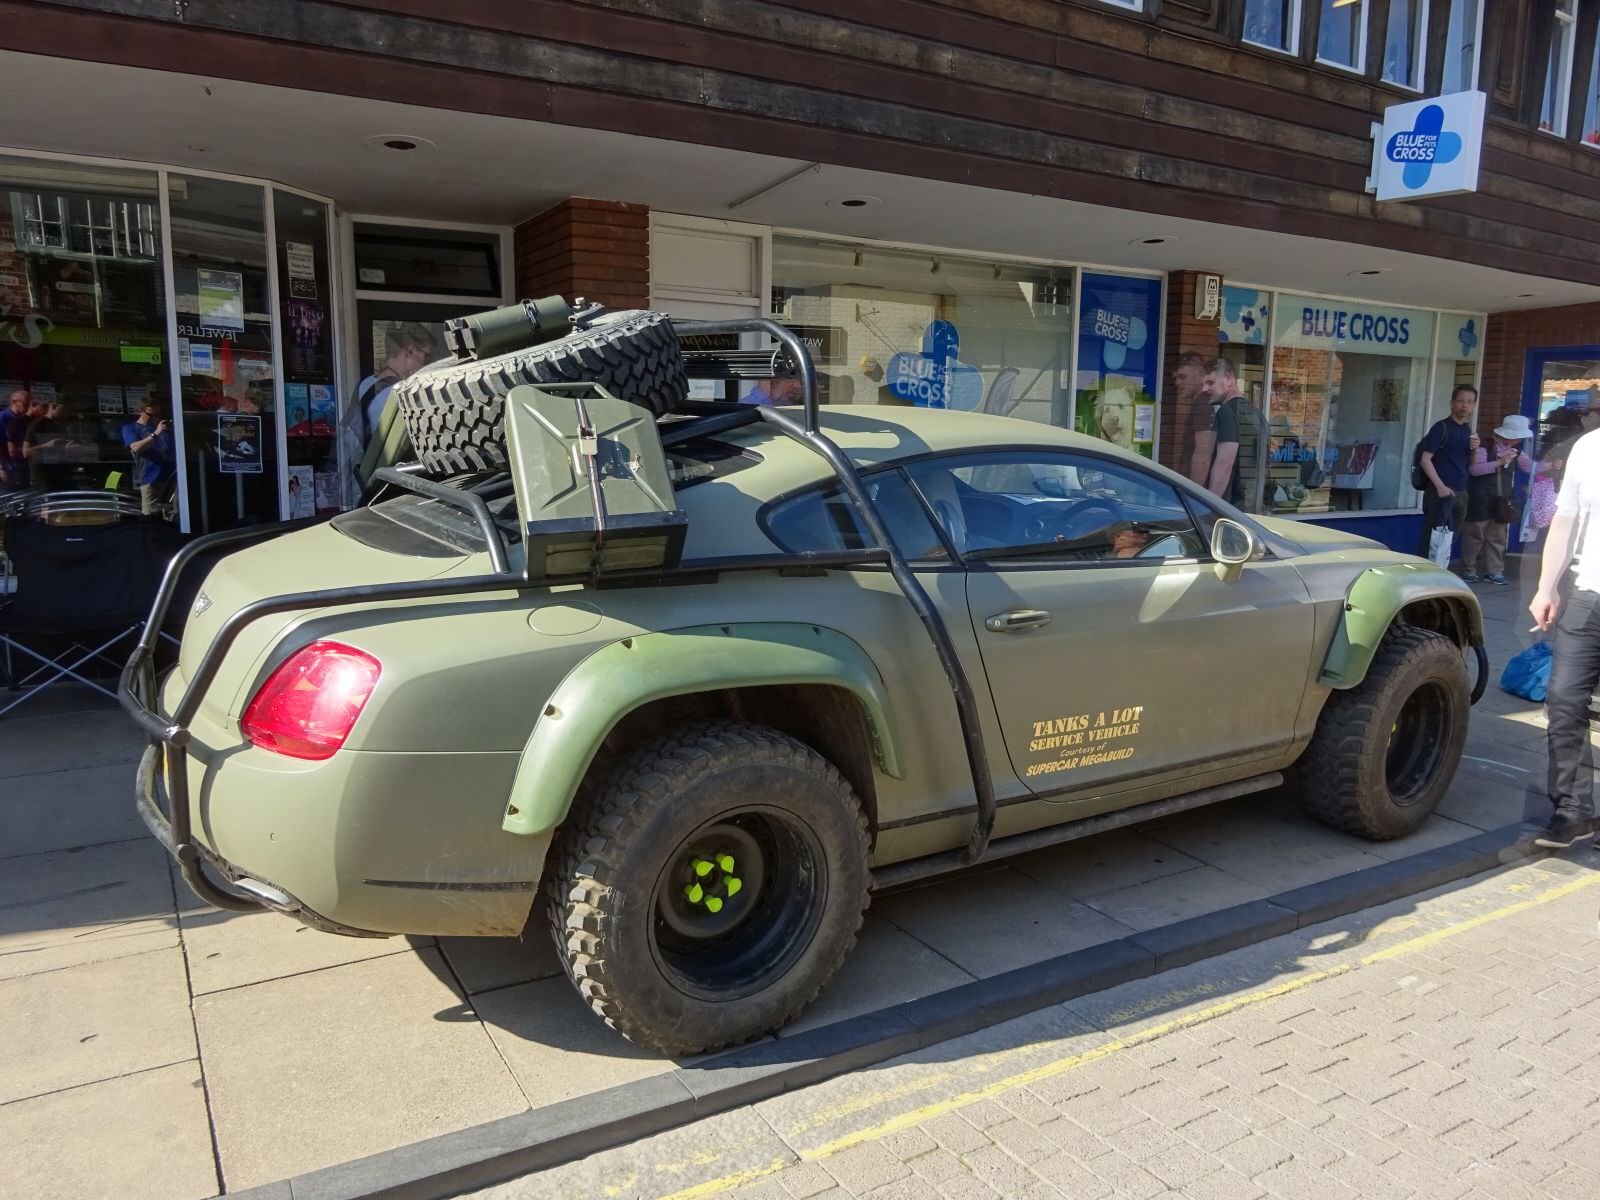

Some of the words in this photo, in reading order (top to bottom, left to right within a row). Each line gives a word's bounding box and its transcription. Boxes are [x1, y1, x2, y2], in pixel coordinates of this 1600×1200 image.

[1395, 134, 1425, 147] BLUE
[1393, 148, 1435, 160] CROSS
[1097, 309, 1121, 327] BLUE
[1302, 307, 1347, 339] BLUE
[1350, 313, 1410, 344] CROSS
[1095, 322, 1128, 343] CROSS
[898, 356, 937, 381] BLUE
[896, 377, 952, 404] CROSS
[1033, 714, 1090, 737] TANKS
[1094, 712, 1106, 728] A
[1112, 706, 1143, 725] LOT
[1029, 732, 1084, 752] SERVICE
[1089, 723, 1139, 740] VEHICLE
[1060, 745, 1095, 757] Courtesy
[1097, 742, 1107, 751] of
[1026, 758, 1078, 776] SUPERCAR
[1080, 748, 1133, 766] MEGABUILD
